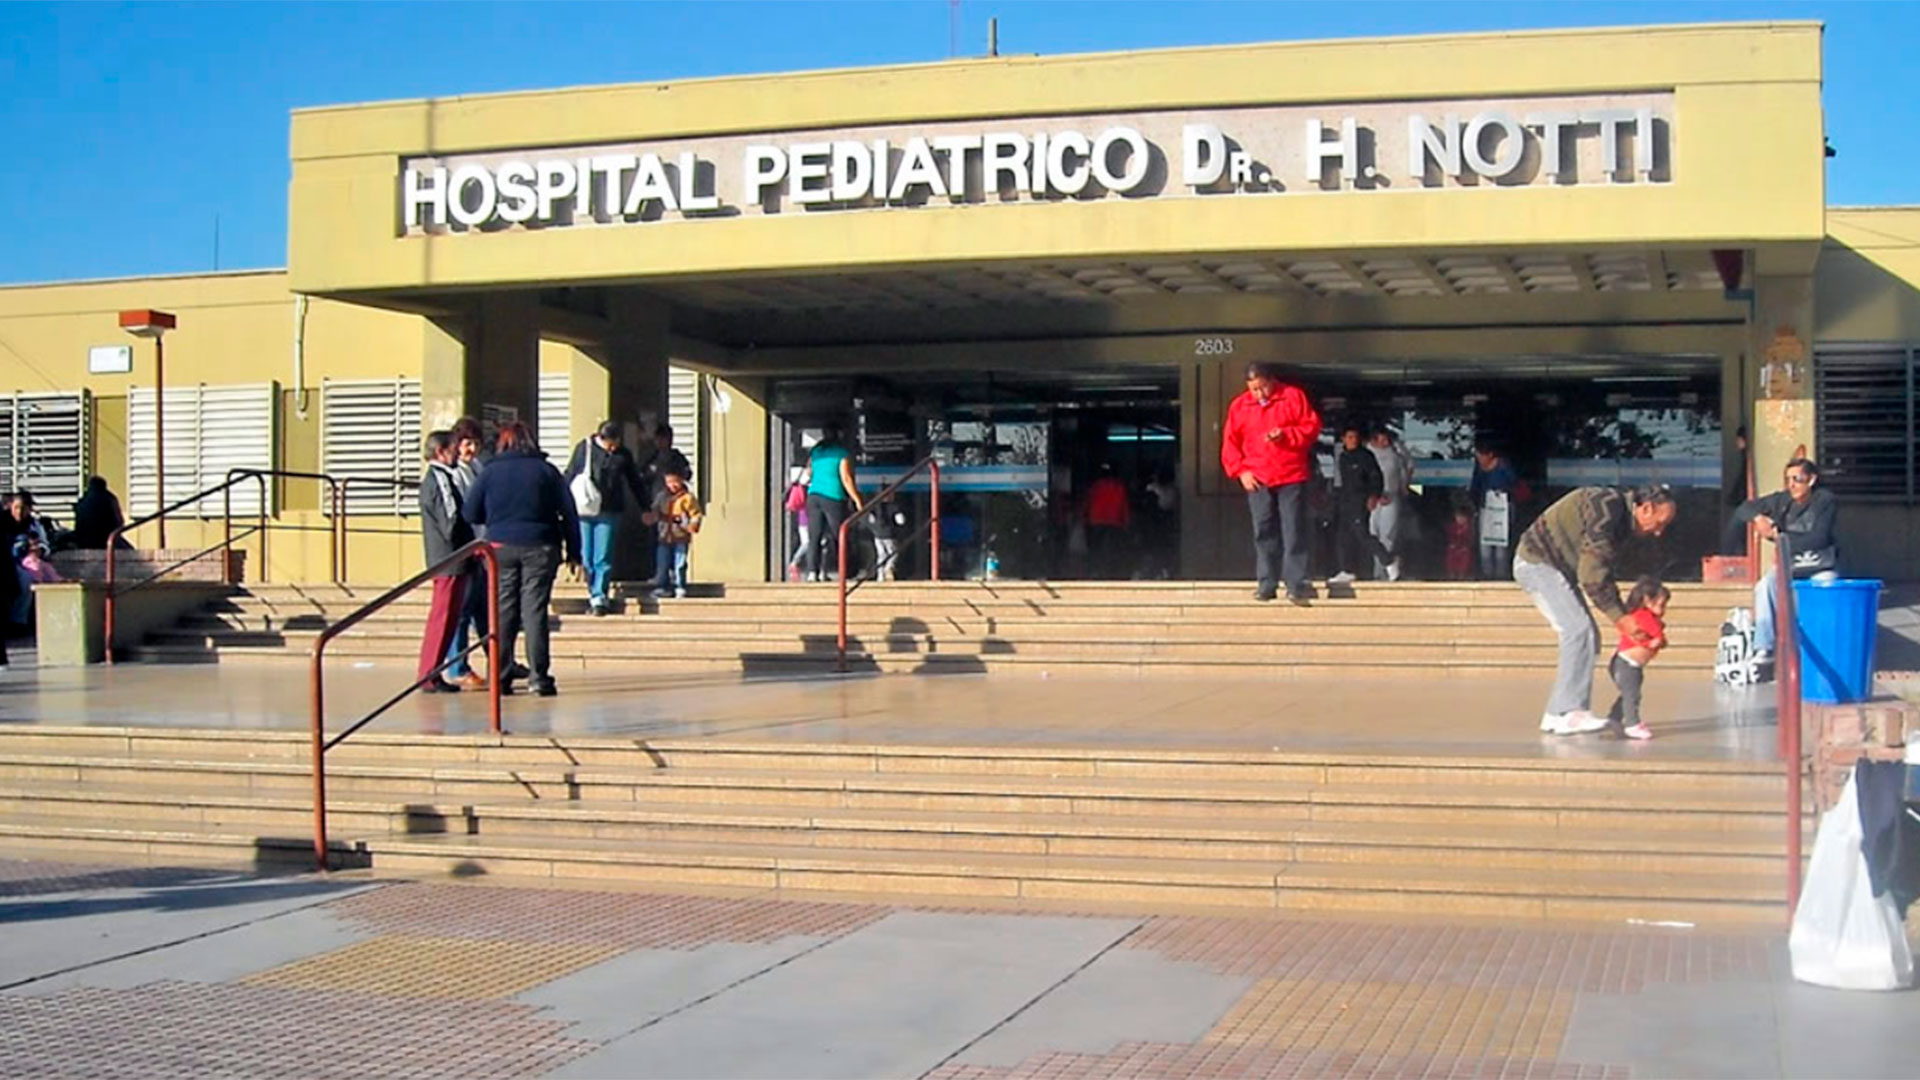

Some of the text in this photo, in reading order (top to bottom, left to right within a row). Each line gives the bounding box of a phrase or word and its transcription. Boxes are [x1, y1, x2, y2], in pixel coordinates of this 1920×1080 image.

[404, 151, 719, 226] HOSPITAL
[746, 126, 1149, 205] PEDIATRICO
[1307, 117, 1375, 182] H.
[1409, 108, 1653, 178] NOTTI
[1195, 339, 1233, 354] 2603
